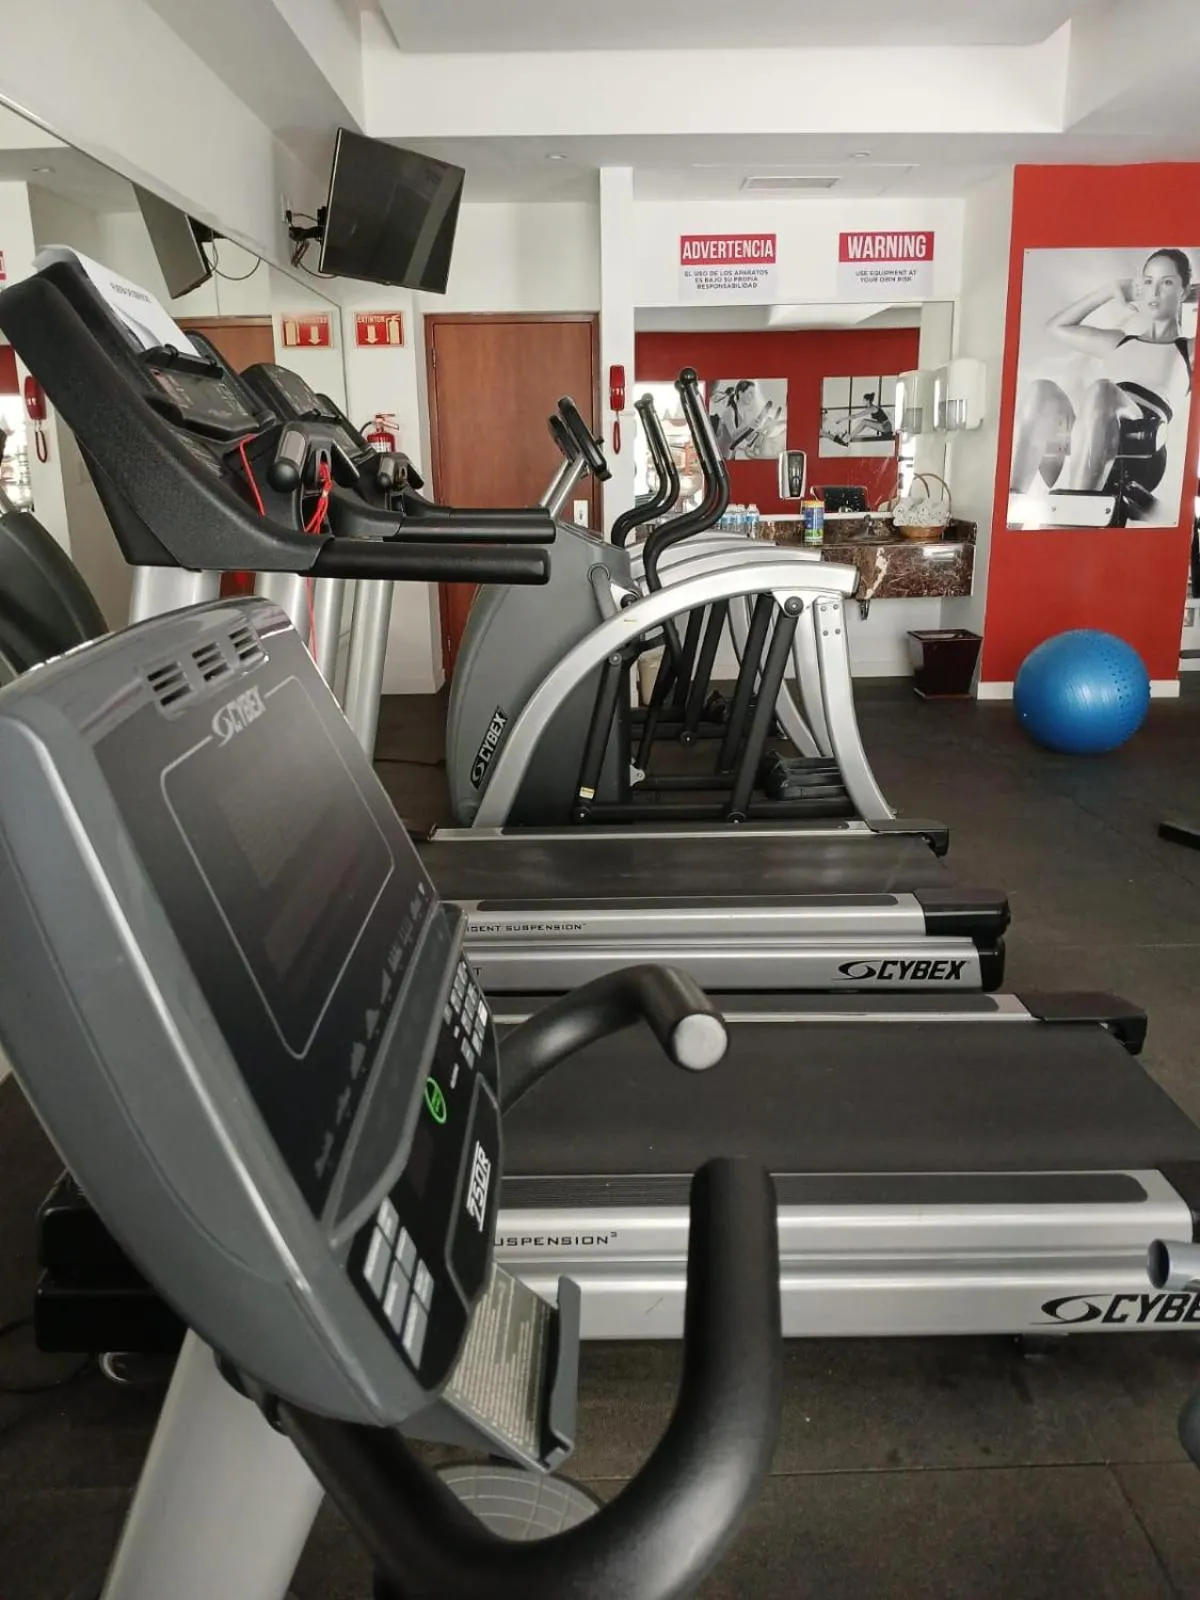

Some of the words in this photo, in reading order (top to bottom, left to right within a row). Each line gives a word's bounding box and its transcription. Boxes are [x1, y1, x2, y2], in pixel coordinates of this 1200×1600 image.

[682, 239, 774, 259] ADVERTENCIA
[847, 234, 927, 259] WARNING
[697, 282, 758, 290] RESPONSABILIDAD
[226, 685, 267, 734] CYBEX
[479, 712, 506, 762] CYBEX
[876, 960, 967, 980] CYBEX
